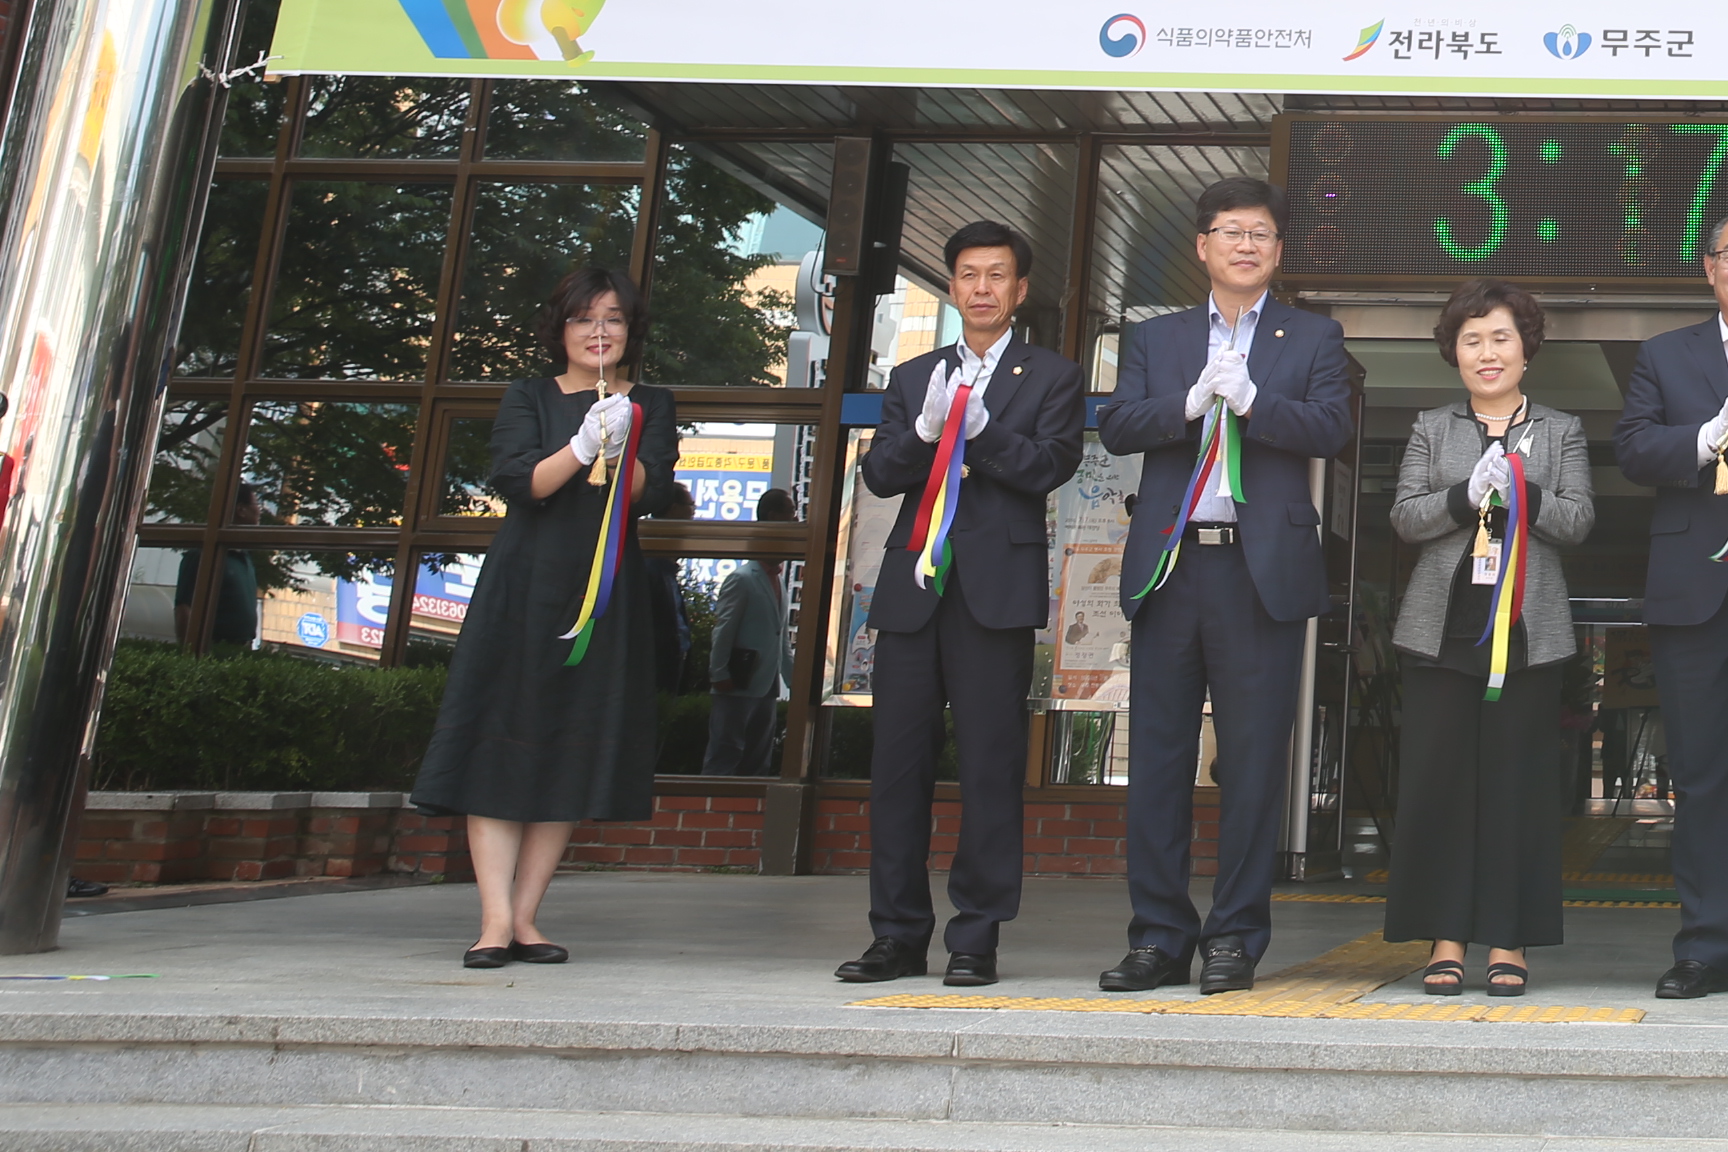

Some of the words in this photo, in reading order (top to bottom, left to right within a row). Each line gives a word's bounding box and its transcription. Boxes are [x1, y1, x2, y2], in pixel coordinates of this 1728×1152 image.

[1155, 27, 1312, 49] 식품의약품안전처
[1388, 30, 1503, 61] 전라북도
[1600, 28, 1695, 58] 무주군
